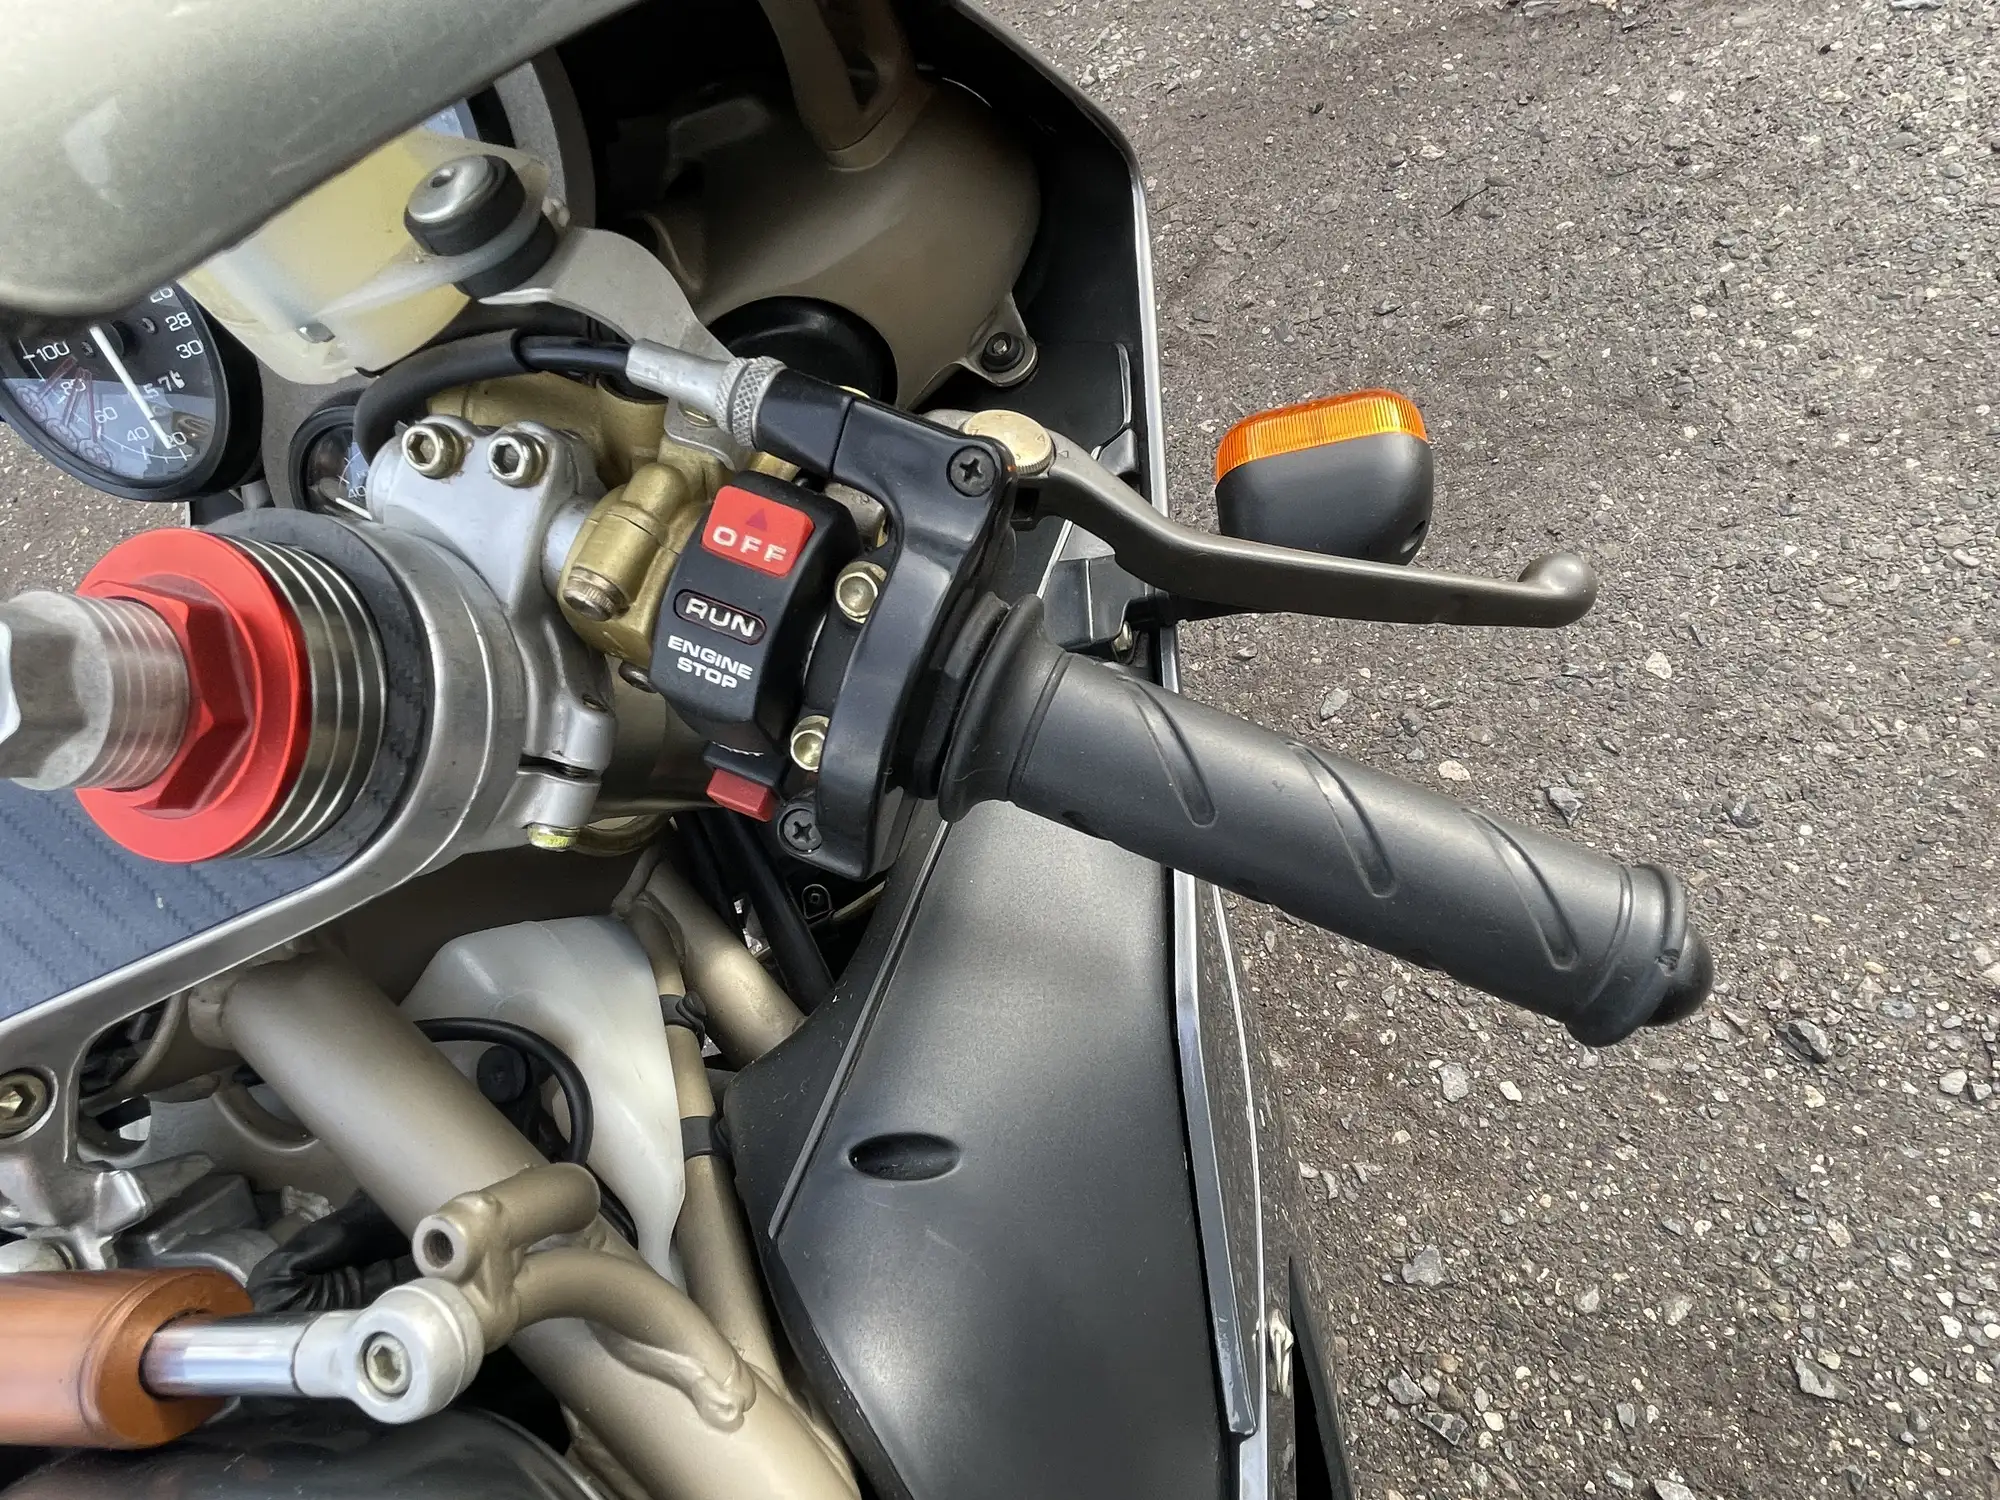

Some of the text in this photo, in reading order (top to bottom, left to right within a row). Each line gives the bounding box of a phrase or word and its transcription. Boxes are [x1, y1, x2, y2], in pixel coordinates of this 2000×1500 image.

[165, 311, 192, 331] 28
[36, 340, 71, 361] 100
[175, 339, 204, 359] 30
[60, 378, 87, 396] 80
[94, 406, 118, 423] 60
[126, 426, 150, 442] 40
[712, 525, 787, 562] OFF
[685, 597, 756, 637] RUN
[667, 634, 753, 680] ENGINE
[676, 656, 738, 689] STOP
